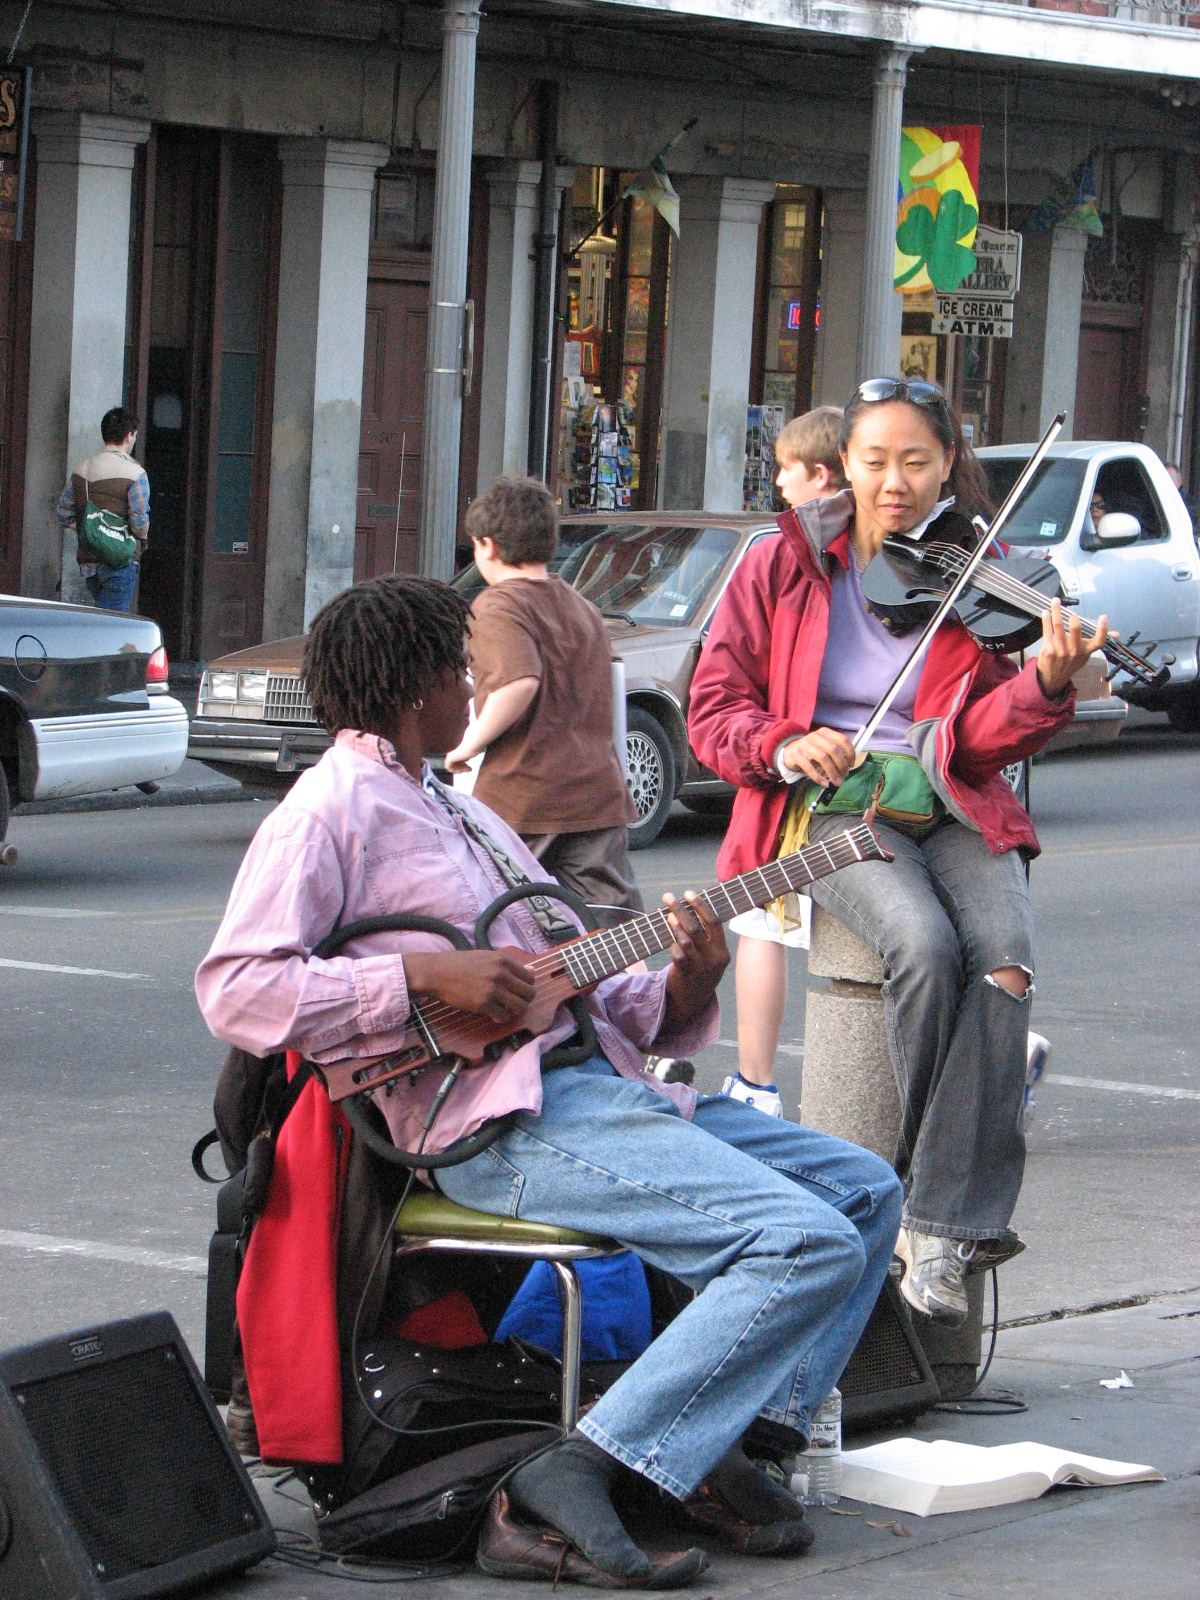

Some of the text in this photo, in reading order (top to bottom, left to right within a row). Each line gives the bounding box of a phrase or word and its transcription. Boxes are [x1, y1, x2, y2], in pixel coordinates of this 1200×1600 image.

[976, 257, 1006, 273] ERA
[961, 274, 1013, 291] ALLERY
[939, 302, 959, 316] ICE
[962, 302, 1003, 317] CREAM
[950, 321, 994, 335] ATM
